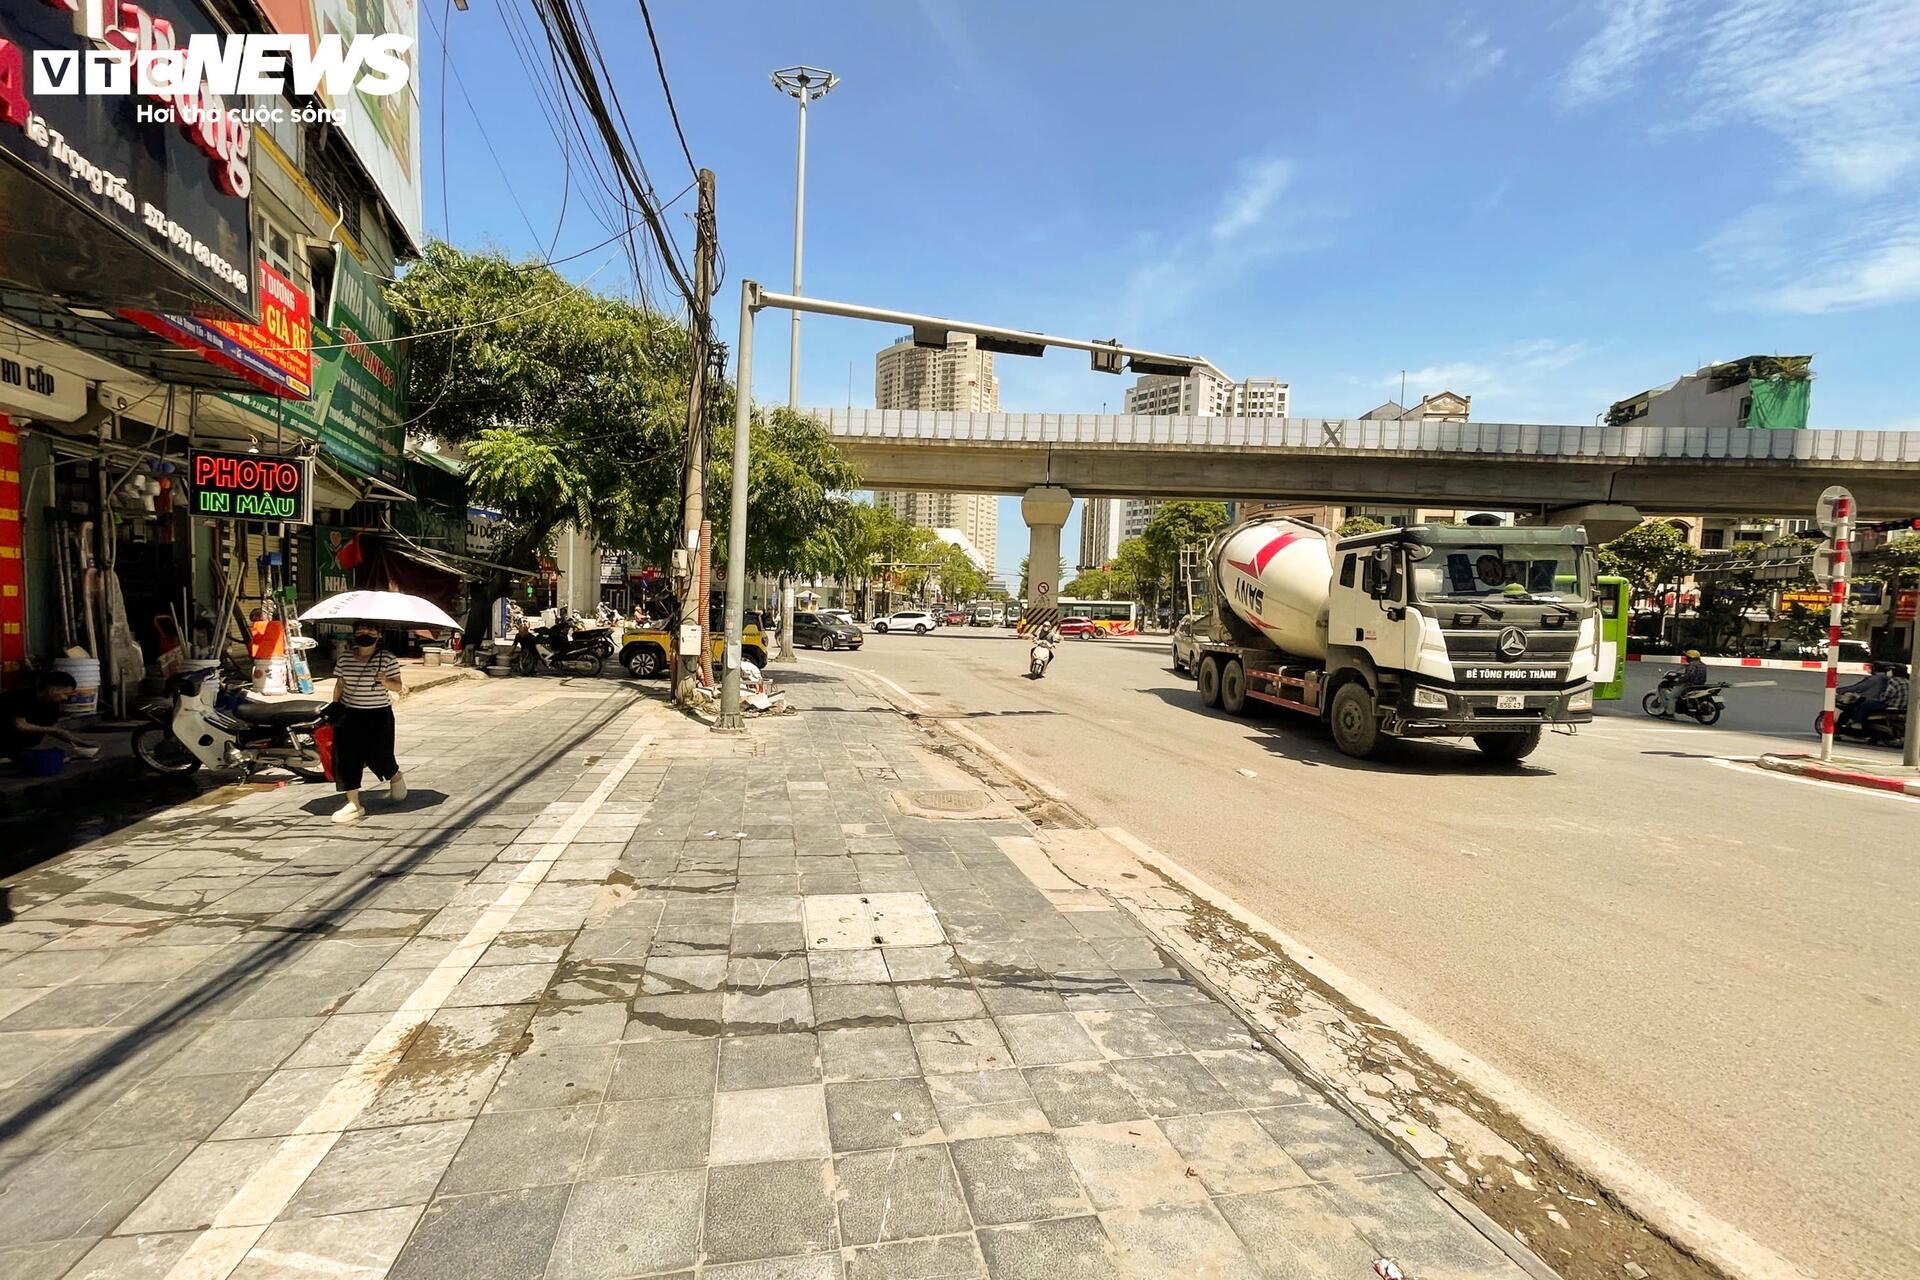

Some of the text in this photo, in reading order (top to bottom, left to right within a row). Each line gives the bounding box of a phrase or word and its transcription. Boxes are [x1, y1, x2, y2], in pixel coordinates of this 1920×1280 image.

[49, 128, 104, 195] Trọng
[102, 170, 136, 213] Tấn
[341, 269, 363, 321] NHÀ
[266, 304, 290, 345] GIÁ
[196, 455, 298, 493] PHOTO
[200, 491, 295, 517] IN MÀU
[324, 573, 348, 592] NHÀ
[1466, 668, 1557, 679] BÊ TÔNG PHÚC THÀNH
